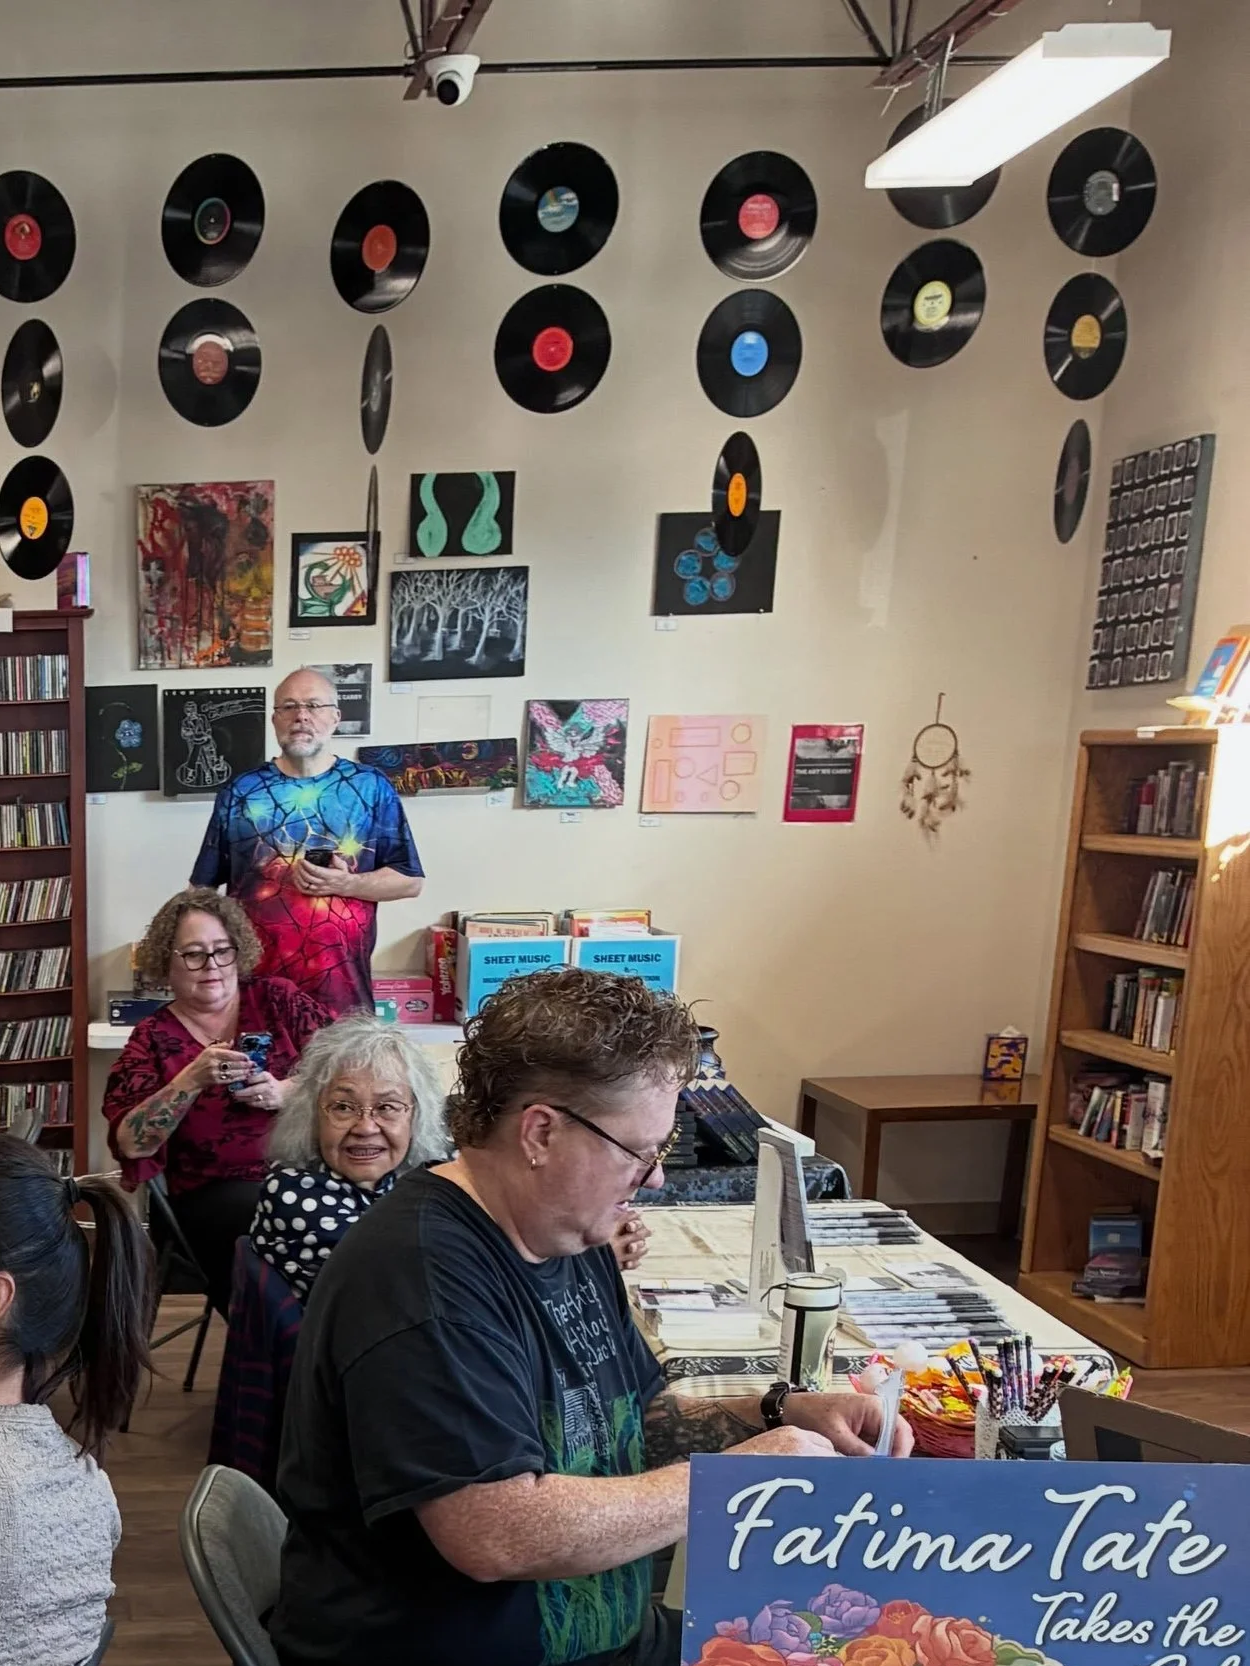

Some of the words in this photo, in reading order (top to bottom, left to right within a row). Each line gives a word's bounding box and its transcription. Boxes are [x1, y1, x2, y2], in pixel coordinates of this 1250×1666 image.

[484, 955, 516, 964] SHEET
[518, 955, 550, 963] MUSIC
[593, 954, 626, 963] SHEET
[628, 953, 661, 962] MUSIC
[726, 1477, 1032, 1573] Fatima
[1044, 1484, 1227, 1581] Tate
[1032, 1591, 1153, 1646] Takes
[1162, 1596, 1246, 1649] the
